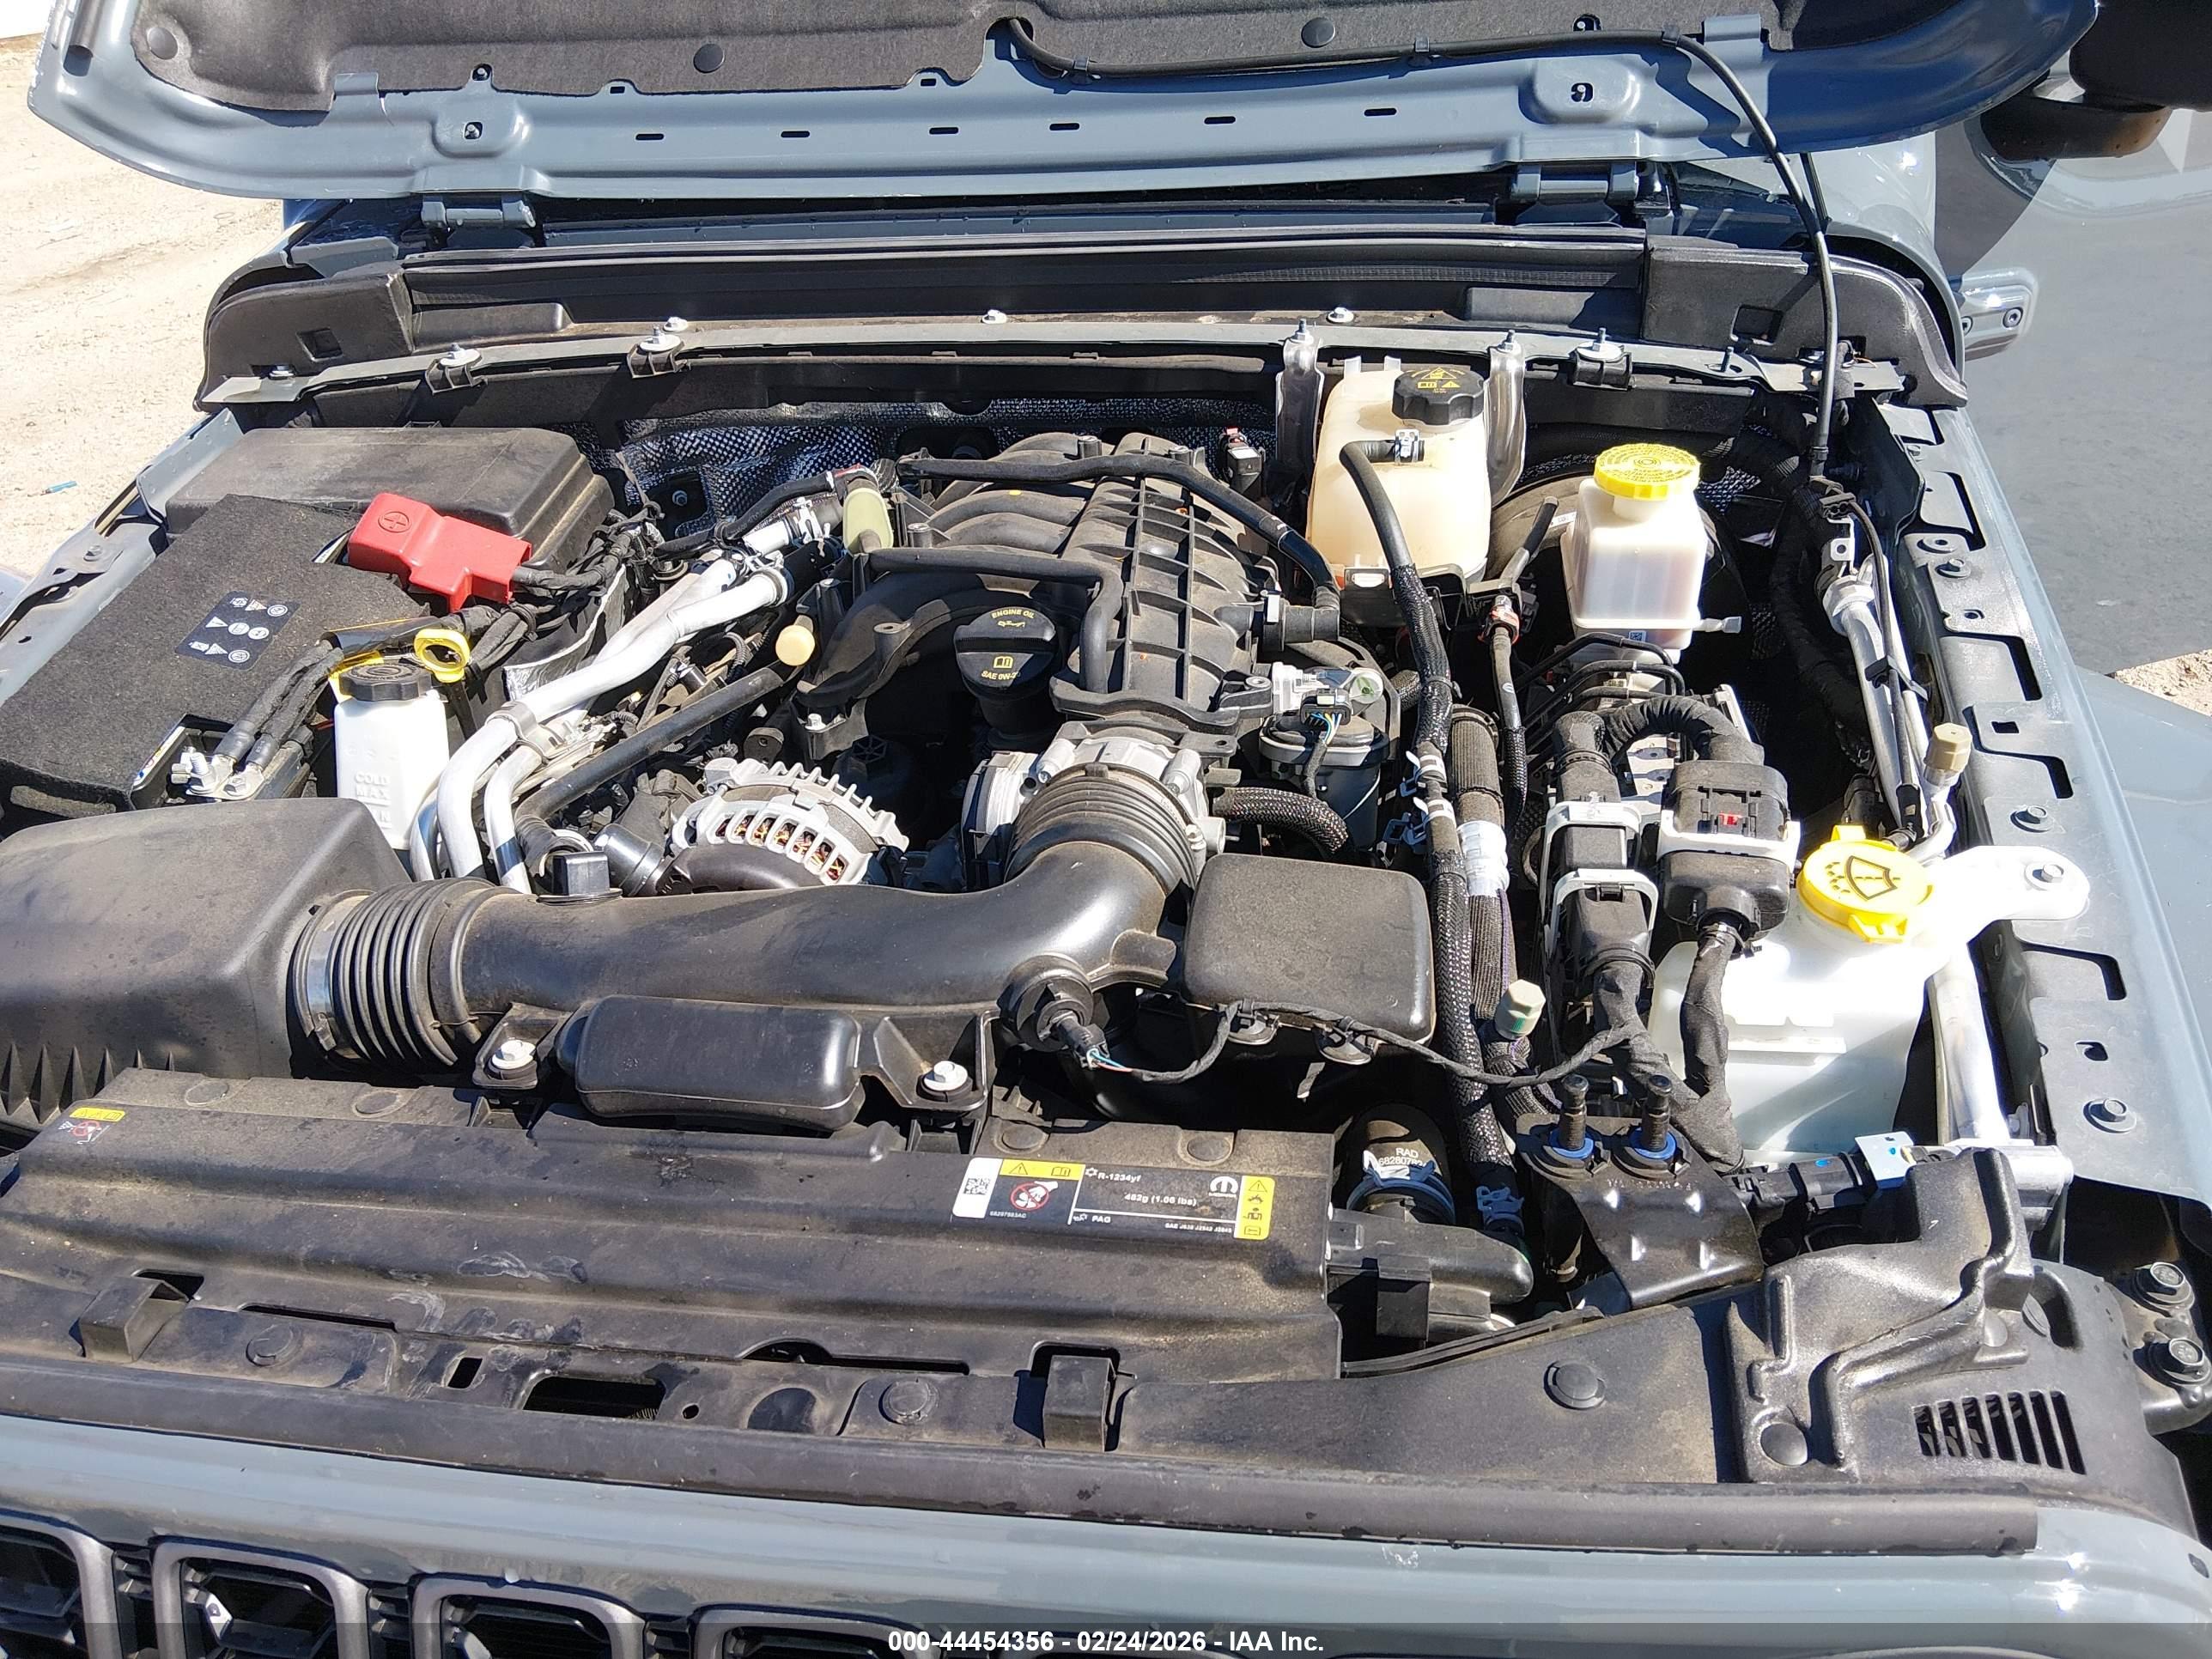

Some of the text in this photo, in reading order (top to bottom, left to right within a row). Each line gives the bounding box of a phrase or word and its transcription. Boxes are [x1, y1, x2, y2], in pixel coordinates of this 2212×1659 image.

[991, 609, 1035, 618] ENGINE OIL
[981, 671, 998, 680] SAE
[355, 772, 390, 786] COLD
[1395, 1147, 1419, 1158] RAD
[1097, 1171, 1141, 1182] R-1234yf
[1177, 1196, 1197, 1206] lbs)
